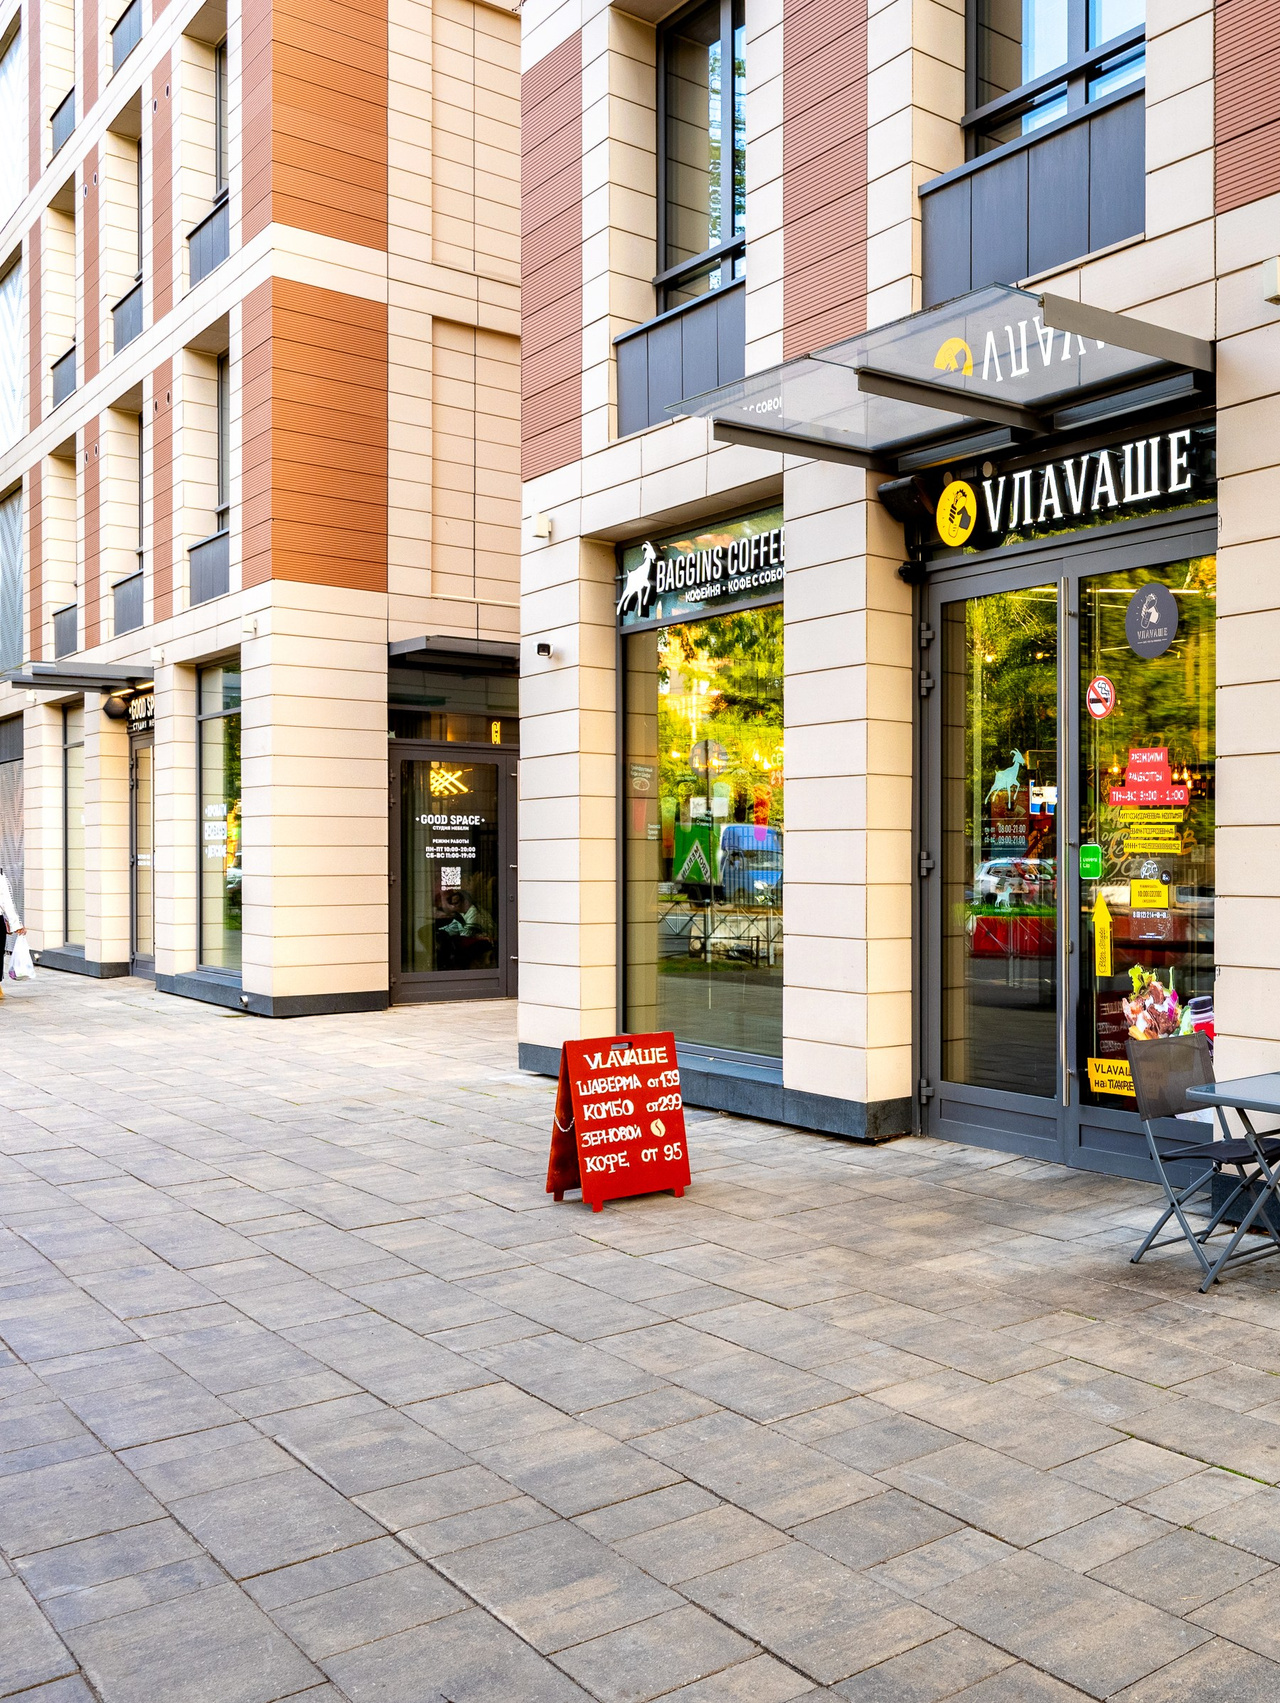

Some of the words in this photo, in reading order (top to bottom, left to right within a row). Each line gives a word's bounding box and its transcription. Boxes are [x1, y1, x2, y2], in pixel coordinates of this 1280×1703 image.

[656, 545, 723, 594] BAGGINS
[685, 583, 721, 602] КОФЕЙНЯ
[728, 575, 752, 593] КОФЕ
[751, 572, 759, 587] С
[420, 814, 448, 825] GOOD
[449, 815, 481, 826] SPACE
[576, 1074, 642, 1096] ШАВЕРМА
[583, 1098, 634, 1121] КОМБО
[581, 1124, 642, 1148] ЗЕРНОВОЙ
[584, 1151, 630, 1173] КОФЕ
[664, 1142, 683, 1161] 95
